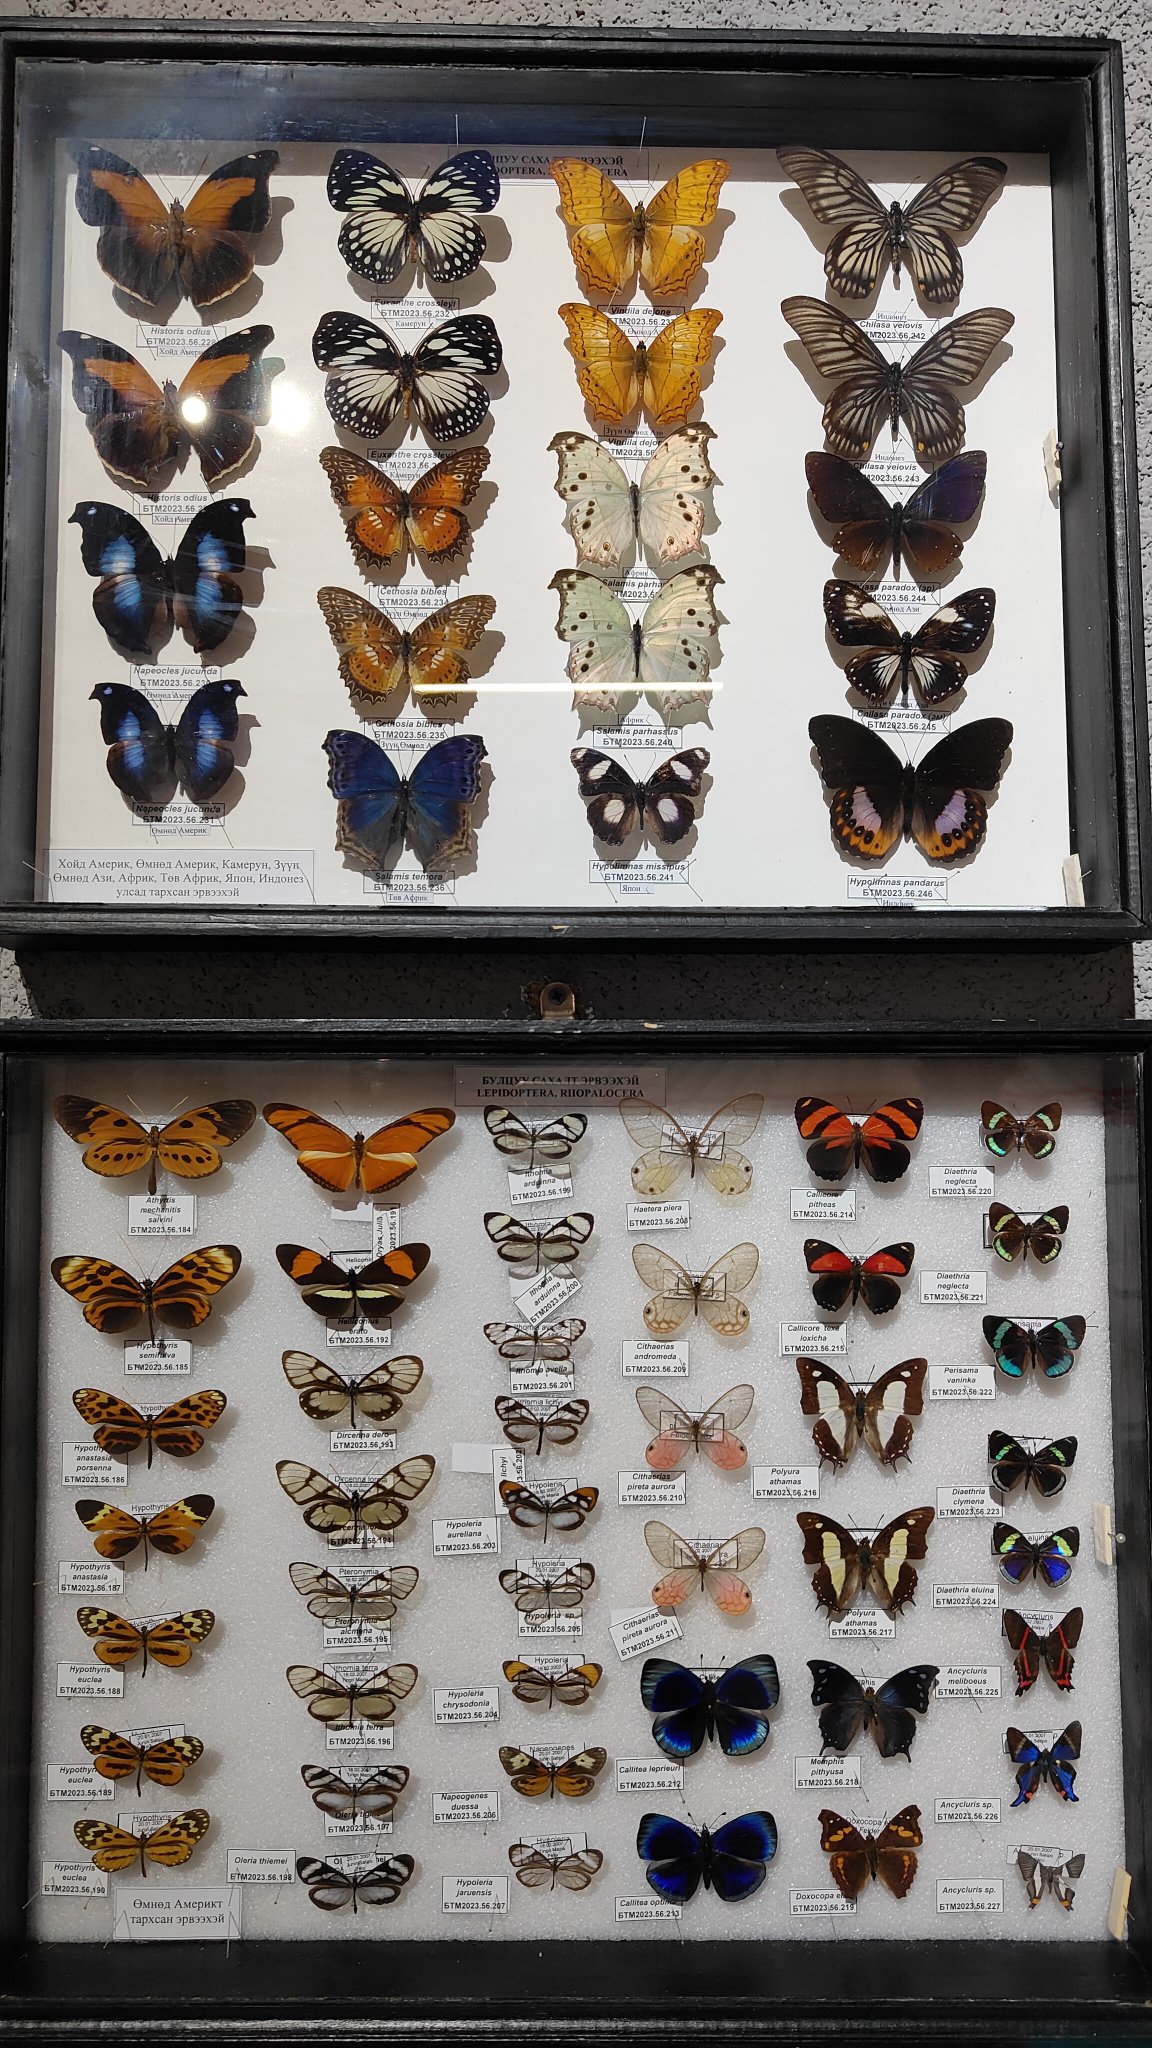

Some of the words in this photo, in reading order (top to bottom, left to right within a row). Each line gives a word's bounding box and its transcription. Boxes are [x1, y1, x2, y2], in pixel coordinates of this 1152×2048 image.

[374, 299, 415, 307] Euxanthe
[416, 299, 456, 308] crossleyi
[381, 309, 450, 318] БТМ2023.56.232
[611, 307, 640, 315] Vindila
[641, 307, 671, 316] dejone
[859, 321, 892, 329] Chilasa
[150, 327, 185, 335] Historis
[853, 462, 885, 471] Chilasa
[887, 463, 917, 471] veiovis
[147, 494, 181, 502] Historis
[183, 494, 208, 502] odius
[602, 579, 636, 587] Salamis
[133, 667, 179, 676] Napeocles
[180, 667, 217, 676] jucunda
[375, 720, 414, 728] Cethosia
[416, 720, 443, 728] bibles
[867, 722, 937, 731] БТМ2023.56.245
[375, 731, 445, 739] БТМ2023.56.235
[596, 728, 631, 736] Salamis
[632, 728, 678, 736] parhassus
[603, 739, 673, 747] БТМ2023.56.240
[136, 805, 182, 814] Napeocles
[183, 805, 221, 814] jucunda
[143, 815, 215, 824] БТМ2023.56.231
[57, 859, 86, 871] Хойд
[88, 859, 133, 872] Америк,
[136, 859, 171, 871] Өмнөд
[175, 859, 219, 872] Америк,
[222, 860, 271, 872] Камерун,
[274, 860, 300, 872] Зүүн
[592, 862, 644, 872] Hypolimnas
[646, 863, 685, 872] missipus
[53, 873, 88, 884] Өмнөд
[92, 873, 116, 884] Ази,
[118, 873, 157, 886] Африк,
[160, 873, 180, 883] Төв
[183, 874, 222, 886] Африк,
[225, 874, 255, 885] Япон,
[259, 874, 304, 885] Индонез
[375, 872, 411, 881] Salamis
[412, 873, 443, 881] temora
[850, 877, 901, 886] Hypolimnas
[903, 878, 945, 887] pandarus
[373, 883, 445, 892] БТМ2023.56.236
[116, 888, 146, 899] улсад
[149, 888, 190, 898] тархсан
[193, 886, 240, 898] эрвээхэй
[862, 889, 933, 898] БТМ2023.56.246
[477, 1088, 558, 1100] LEPIDOPTERA,
[560, 1088, 645, 1099] RHOPALOCERA
[944, 1167, 977, 1175] Diaethria
[945, 1177, 977, 1186] neglecta
[806, 1190, 839, 1198] Callicore
[932, 1187, 992, 1196] БТМ2023.56.220
[634, 1205, 662, 1213] Haetera
[664, 1204, 682, 1214] piera
[808, 1200, 836, 1209] pitheas
[140, 1206, 181, 1214] mechanitis
[793, 1210, 853, 1219] БТМ2023.56.214
[131, 1226, 191, 1234] БТМ2023.56.184
[937, 1272, 970, 1280] Diaethria
[937, 1282, 969, 1291] neglecta
[924, 1293, 984, 1301] БТМ2023.56.221
[329, 1336, 389, 1345] БТМ2023.56.192
[800, 1334, 827, 1342] loxicha
[136, 1341, 178, 1351] Hypothyris
[636, 1342, 674, 1350] Cithaerias
[784, 1344, 845, 1353] БТМ2023.56.215
[634, 1352, 677, 1360] andromeda
[128, 1363, 188, 1371] БТМ2023.56.185
[626, 1365, 686, 1373] БТМ2023.56.209
[944, 1367, 979, 1375] Perisama
[947, 1376, 976, 1384] vaninka
[932, 1388, 993, 1396] БТМ2023.56.222
[336, 1431, 370, 1440] Dircenna
[372, 1431, 390, 1439] dero
[76, 1464, 112, 1472] porsenna
[771, 1467, 800, 1476] Polyura
[64, 1475, 125, 1484] БТМ2023.56.186
[632, 1472, 671, 1480] Cithaerias
[769, 1477, 802, 1485] athamas
[627, 1483, 649, 1492] pireta
[952, 1487, 986, 1495] Diaethria
[756, 1488, 817, 1497] БТМ2023.56.216
[622, 1494, 683, 1502] БТМ2023.56.210
[953, 1498, 985, 1506] clymena
[940, 1508, 1000, 1516] БТМ2023.56.223
[446, 1520, 482, 1530] Hypoleria
[447, 1530, 482, 1538] aureliana
[435, 1542, 496, 1553] БТМ2023.56.203
[70, 1563, 111, 1571] Hypothyris
[72, 1573, 108, 1581] anastasia
[61, 1584, 121, 1592] БТМ2023.56.187
[937, 1586, 970, 1594] Diaethria
[971, 1586, 995, 1594] eluina
[936, 1597, 996, 1606] БТМ2023.56.224
[846, 1609, 875, 1618] Polyura
[623, 1611, 660, 1631] Cithaerias
[845, 1619, 877, 1627] athamas
[520, 1625, 581, 1634] БТМ2023.56.205
[831, 1628, 892, 1636] БТМ2023.56.217
[326, 1636, 388, 1645] БТМ2023.56.195
[69, 1665, 111, 1674] Hypothyris
[947, 1667, 988, 1676] Ancycluris
[948, 1677, 987, 1685] meliboeus
[60, 1686, 121, 1695] БТМ2023.56.188
[448, 1690, 484, 1699] Hypoleria
[938, 1687, 999, 1696] БТМ2023.56.225
[443, 1699, 489, 1708] chrysodonia
[329, 1737, 391, 1746] БТМ2023.56.196
[810, 1758, 844, 1766] Memphis
[811, 1767, 844, 1776] pithyusa
[619, 1780, 681, 1790] БТМ2023.56.212
[798, 1778, 859, 1787] БТМ2023.56.218
[50, 1789, 112, 1797] БТМ2023.56.189
[441, 1792, 488, 1802] Napeogenes
[451, 1802, 479, 1811] duessa
[941, 1800, 981, 1810] Ancycluris
[982, 1802, 994, 1810] sp.
[937, 1812, 998, 1821] БТМ2023.56.226
[234, 1857, 256, 1865] Oleria
[259, 1857, 288, 1865] thiemei
[54, 1863, 95, 1872] Hypothyris
[230, 1873, 292, 1881] БТМ2023.56.198
[456, 1878, 493, 1888] Hypoleria
[456, 1888, 492, 1897] jaruensis
[942, 1885, 982, 1895] Ancycluris
[984, 1887, 996, 1895] sp.
[796, 1892, 834, 1901] Doxocopa
[133, 1898, 171, 1910] Өмнөд
[174, 1899, 223, 1911] Америкт
[444, 1902, 505, 1910] БТМ2023.56.207
[792, 1903, 855, 1912] БТМ2023.56.219
[940, 1902, 1000, 1911] БТМ2023.56.227
[130, 1914, 173, 1925] тархсан
[176, 1913, 225, 1926] эрвээхэй
